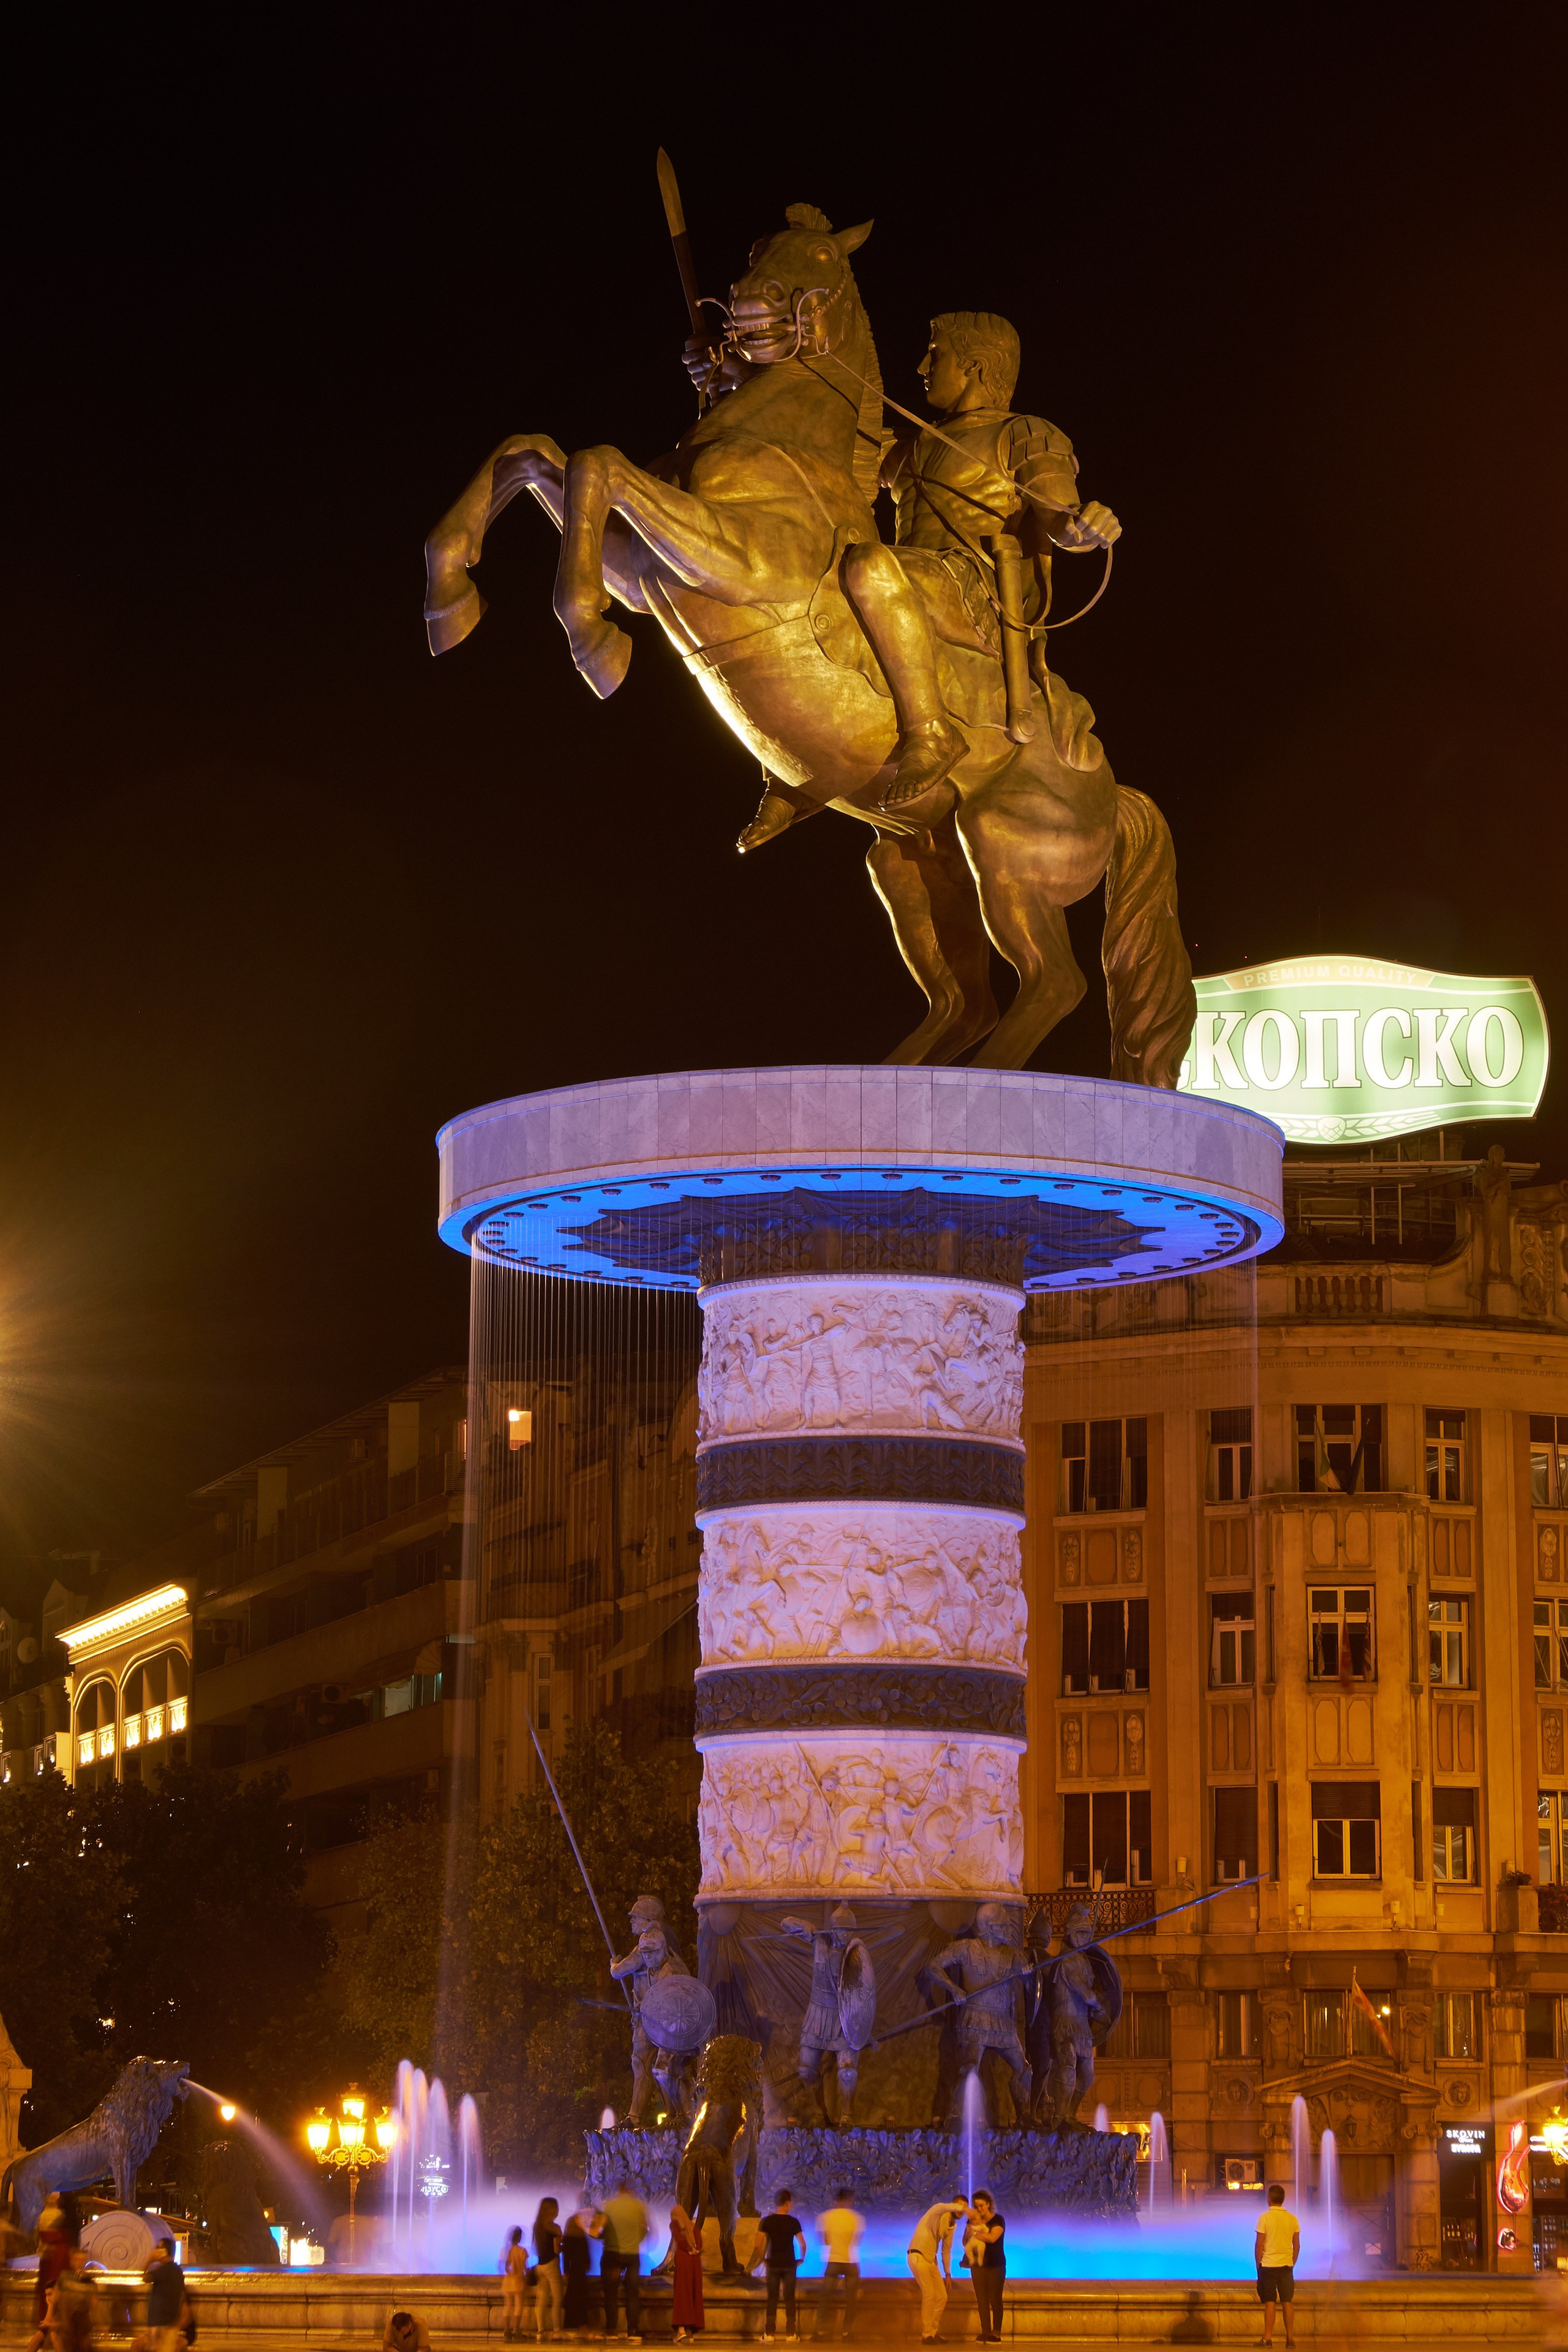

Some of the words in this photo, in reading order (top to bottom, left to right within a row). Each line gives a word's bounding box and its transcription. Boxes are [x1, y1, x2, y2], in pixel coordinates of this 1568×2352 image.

[1243, 965, 1330, 987] PREMIUM
[1339, 965, 1417, 984] QUALITY
[1177, 1006, 1525, 1090] КОПСКО
[1446, 2130, 1485, 2139] SKOVIN
